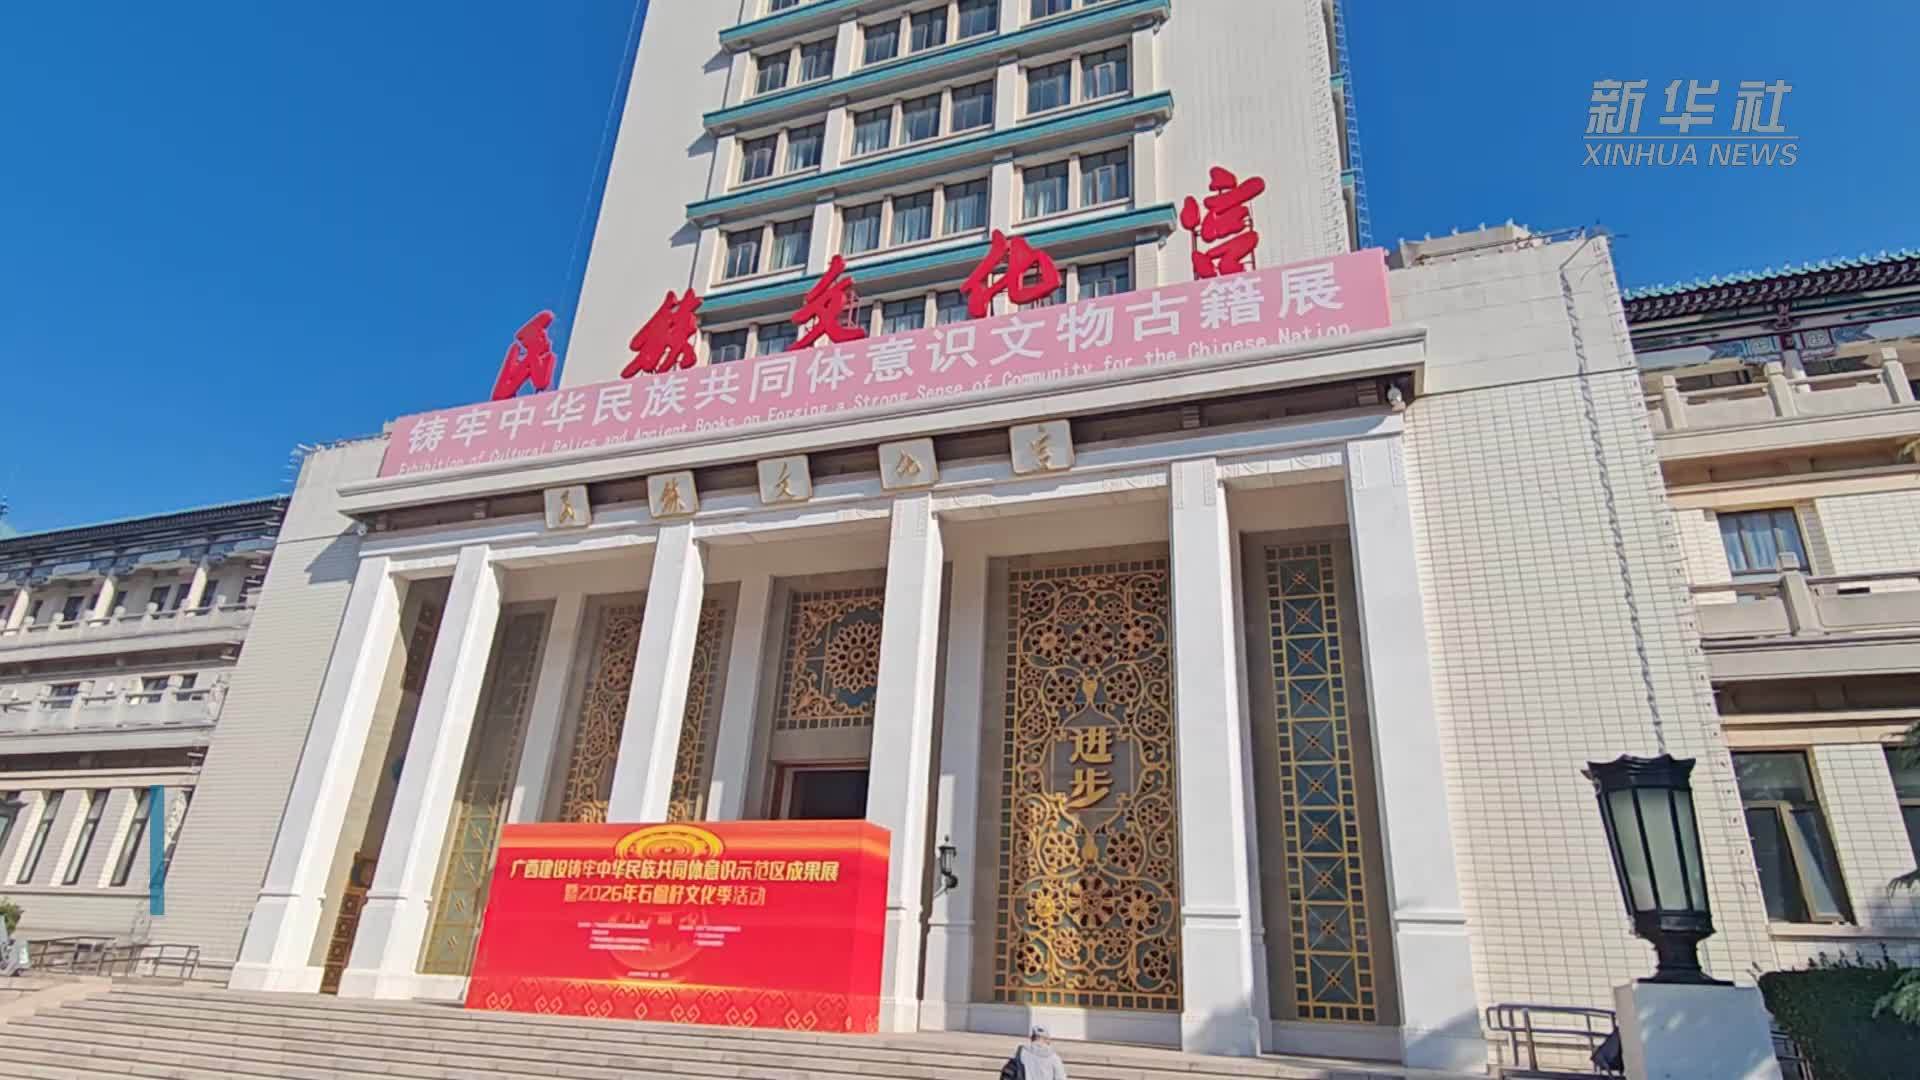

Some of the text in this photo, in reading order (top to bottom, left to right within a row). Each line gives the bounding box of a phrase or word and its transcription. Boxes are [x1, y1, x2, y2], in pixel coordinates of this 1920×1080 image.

[409, 262, 1344, 454] 铸牢中华民族共同体意识文物古籍展
[695, 414, 736, 432] Books
[973, 373, 993, 391] of
[1104, 355, 1133, 371] for
[1144, 347, 1177, 366] the
[1188, 336, 1268, 359] Chinese
[1278, 322, 1350, 345] Nation
[1067, 726, 1113, 808] 进步
